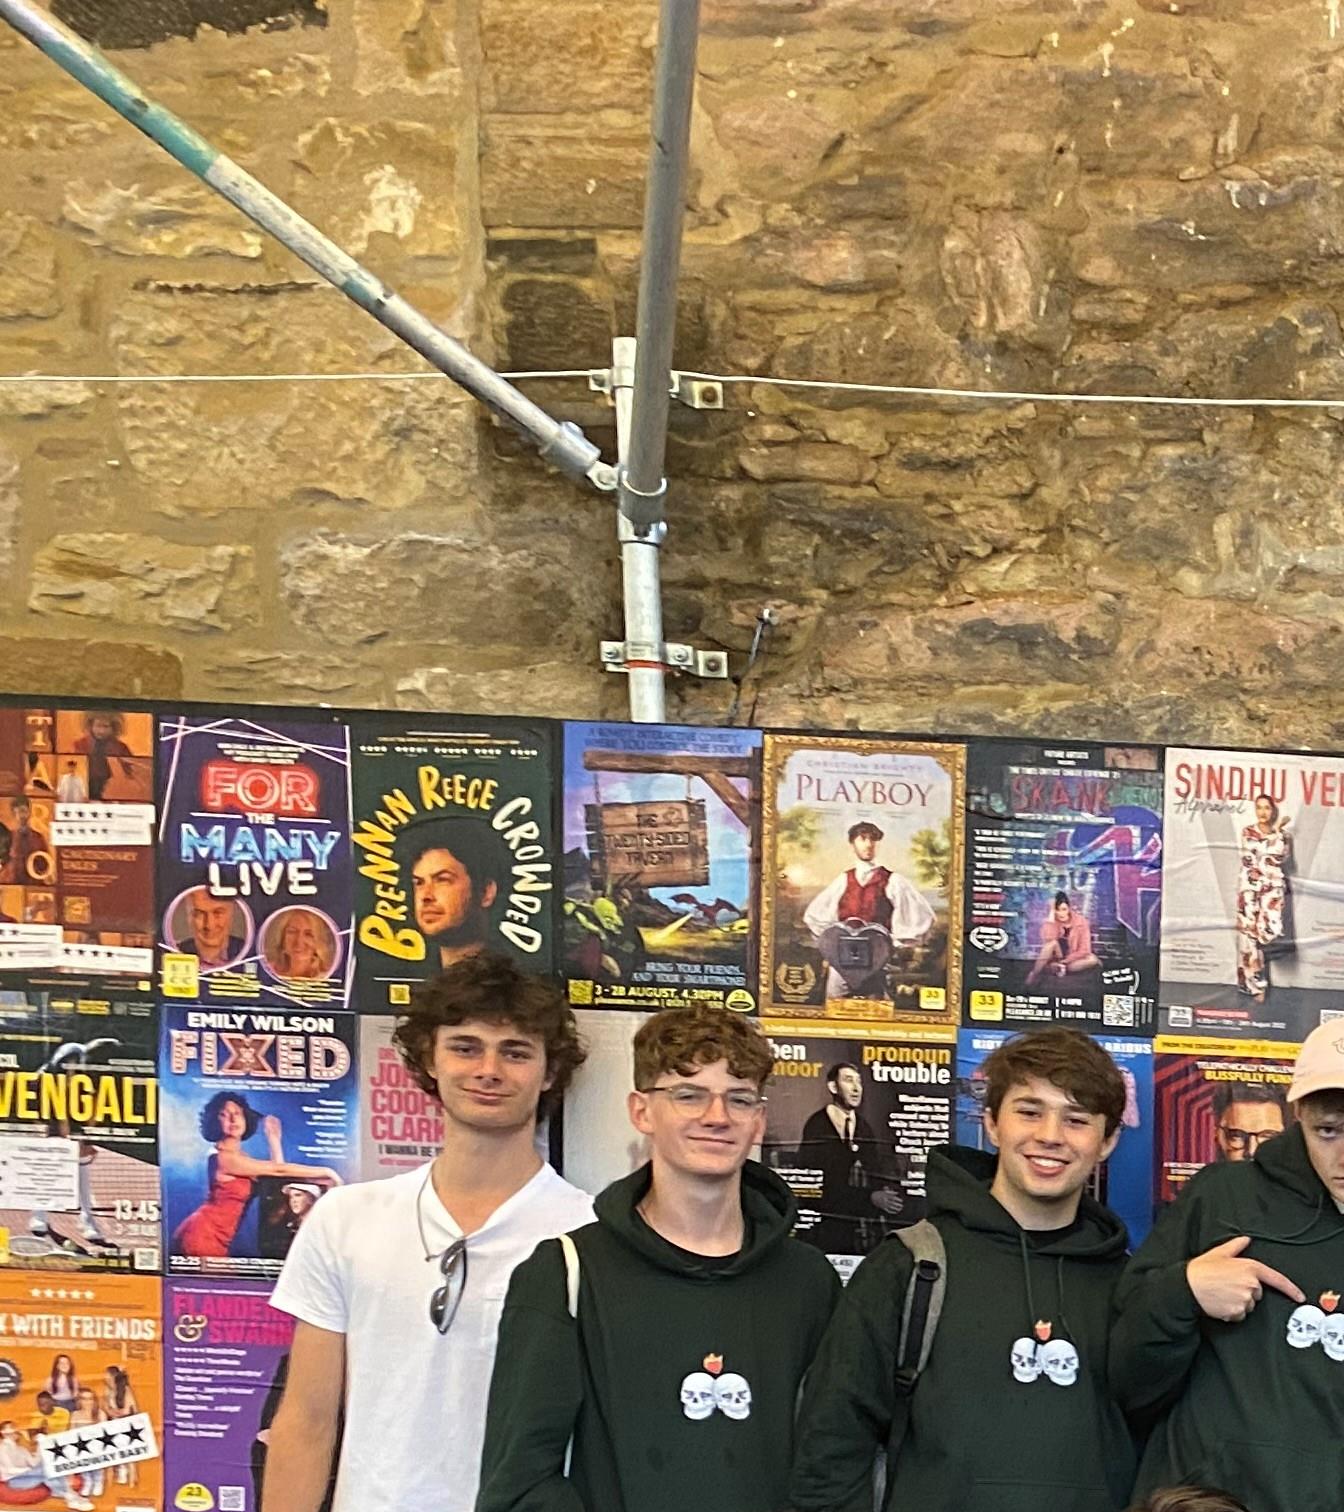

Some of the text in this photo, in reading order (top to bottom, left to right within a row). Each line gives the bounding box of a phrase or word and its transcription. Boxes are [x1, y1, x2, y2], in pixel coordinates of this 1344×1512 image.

[207, 765, 317, 812] FOR
[417, 765, 499, 811] REECE
[795, 773, 936, 808] PLAYBOY
[1011, 774, 1113, 816] SKANK
[1174, 763, 1288, 804] SINDHU
[246, 812, 276, 825] THE
[180, 822, 342, 870] MANY
[208, 862, 318, 897] LIVE
[978, 994, 996, 1006] 33
[187, 1012, 335, 1034] EMILY WILSON
[170, 1029, 351, 1081] FIXED
[862, 1045, 952, 1065] pronoun
[871, 1060, 952, 1085] trouble
[0, 1070, 157, 1124] VENGALI
[370, 1115, 446, 1143] CLARK
[11, 1312, 157, 1341] WITH FRIENDS
[173, 1314, 208, 1343] &
[54, 1446, 150, 1475] BROADWAY BABY
[186, 1486, 203, 1498] 23
